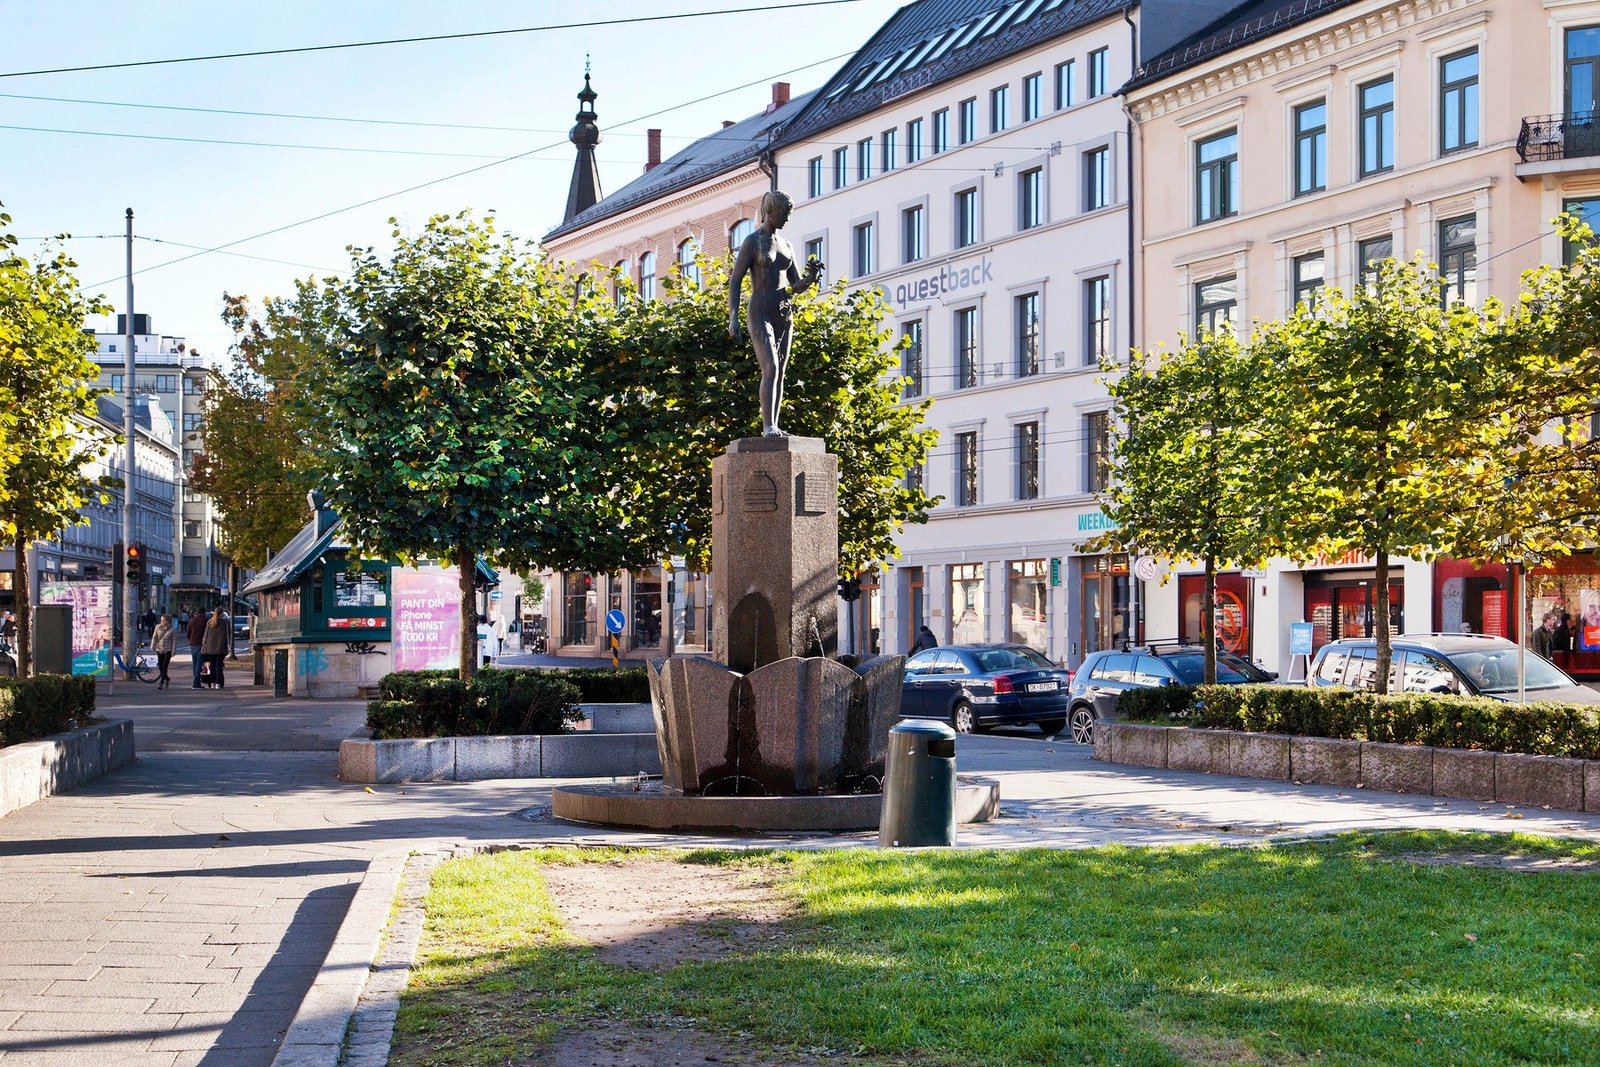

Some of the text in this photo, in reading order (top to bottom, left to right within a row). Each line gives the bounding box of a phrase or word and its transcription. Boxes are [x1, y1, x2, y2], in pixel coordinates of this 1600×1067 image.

[897, 255, 994, 310] questback
[401, 599, 445, 608] PANT DIN
[401, 610, 432, 619] iPhone
[401, 619, 444, 630] FÅ MINST
[426, 632, 439, 641] KR
